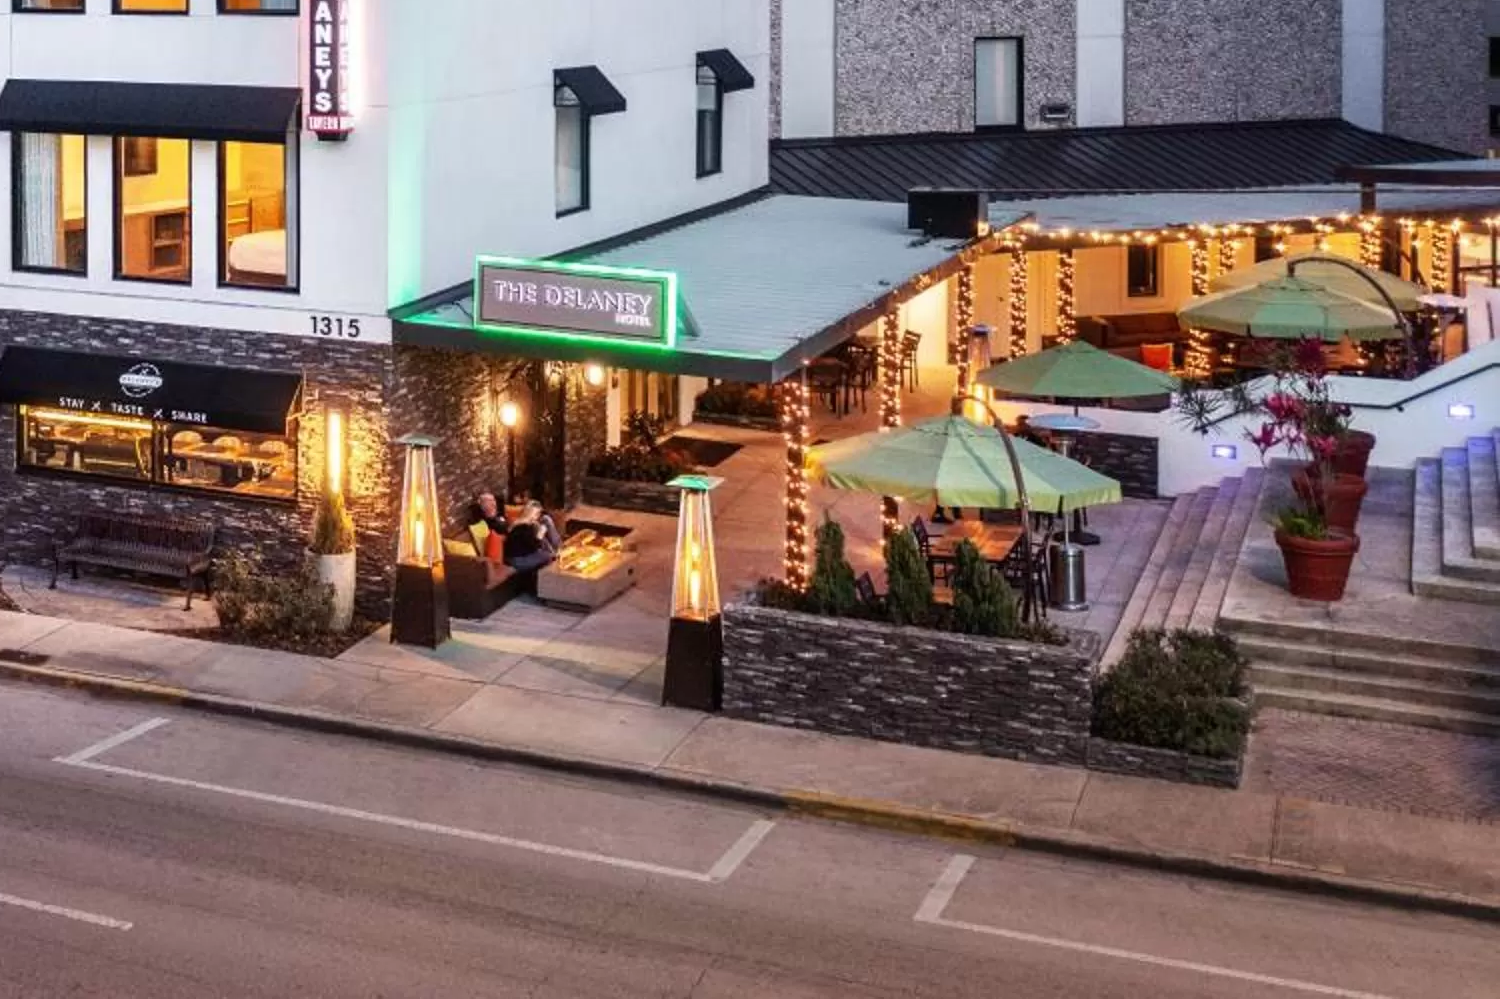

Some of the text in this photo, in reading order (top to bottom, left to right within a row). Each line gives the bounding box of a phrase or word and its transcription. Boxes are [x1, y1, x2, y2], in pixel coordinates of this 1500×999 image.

[493, 280, 652, 316] THE DELANEY
[310, 316, 360, 338] 1315
[615, 313, 652, 327] HOTEL
[59, 396, 85, 409] STAY
[111, 402, 144, 416] TASTE
[171, 410, 208, 424] SHARE
